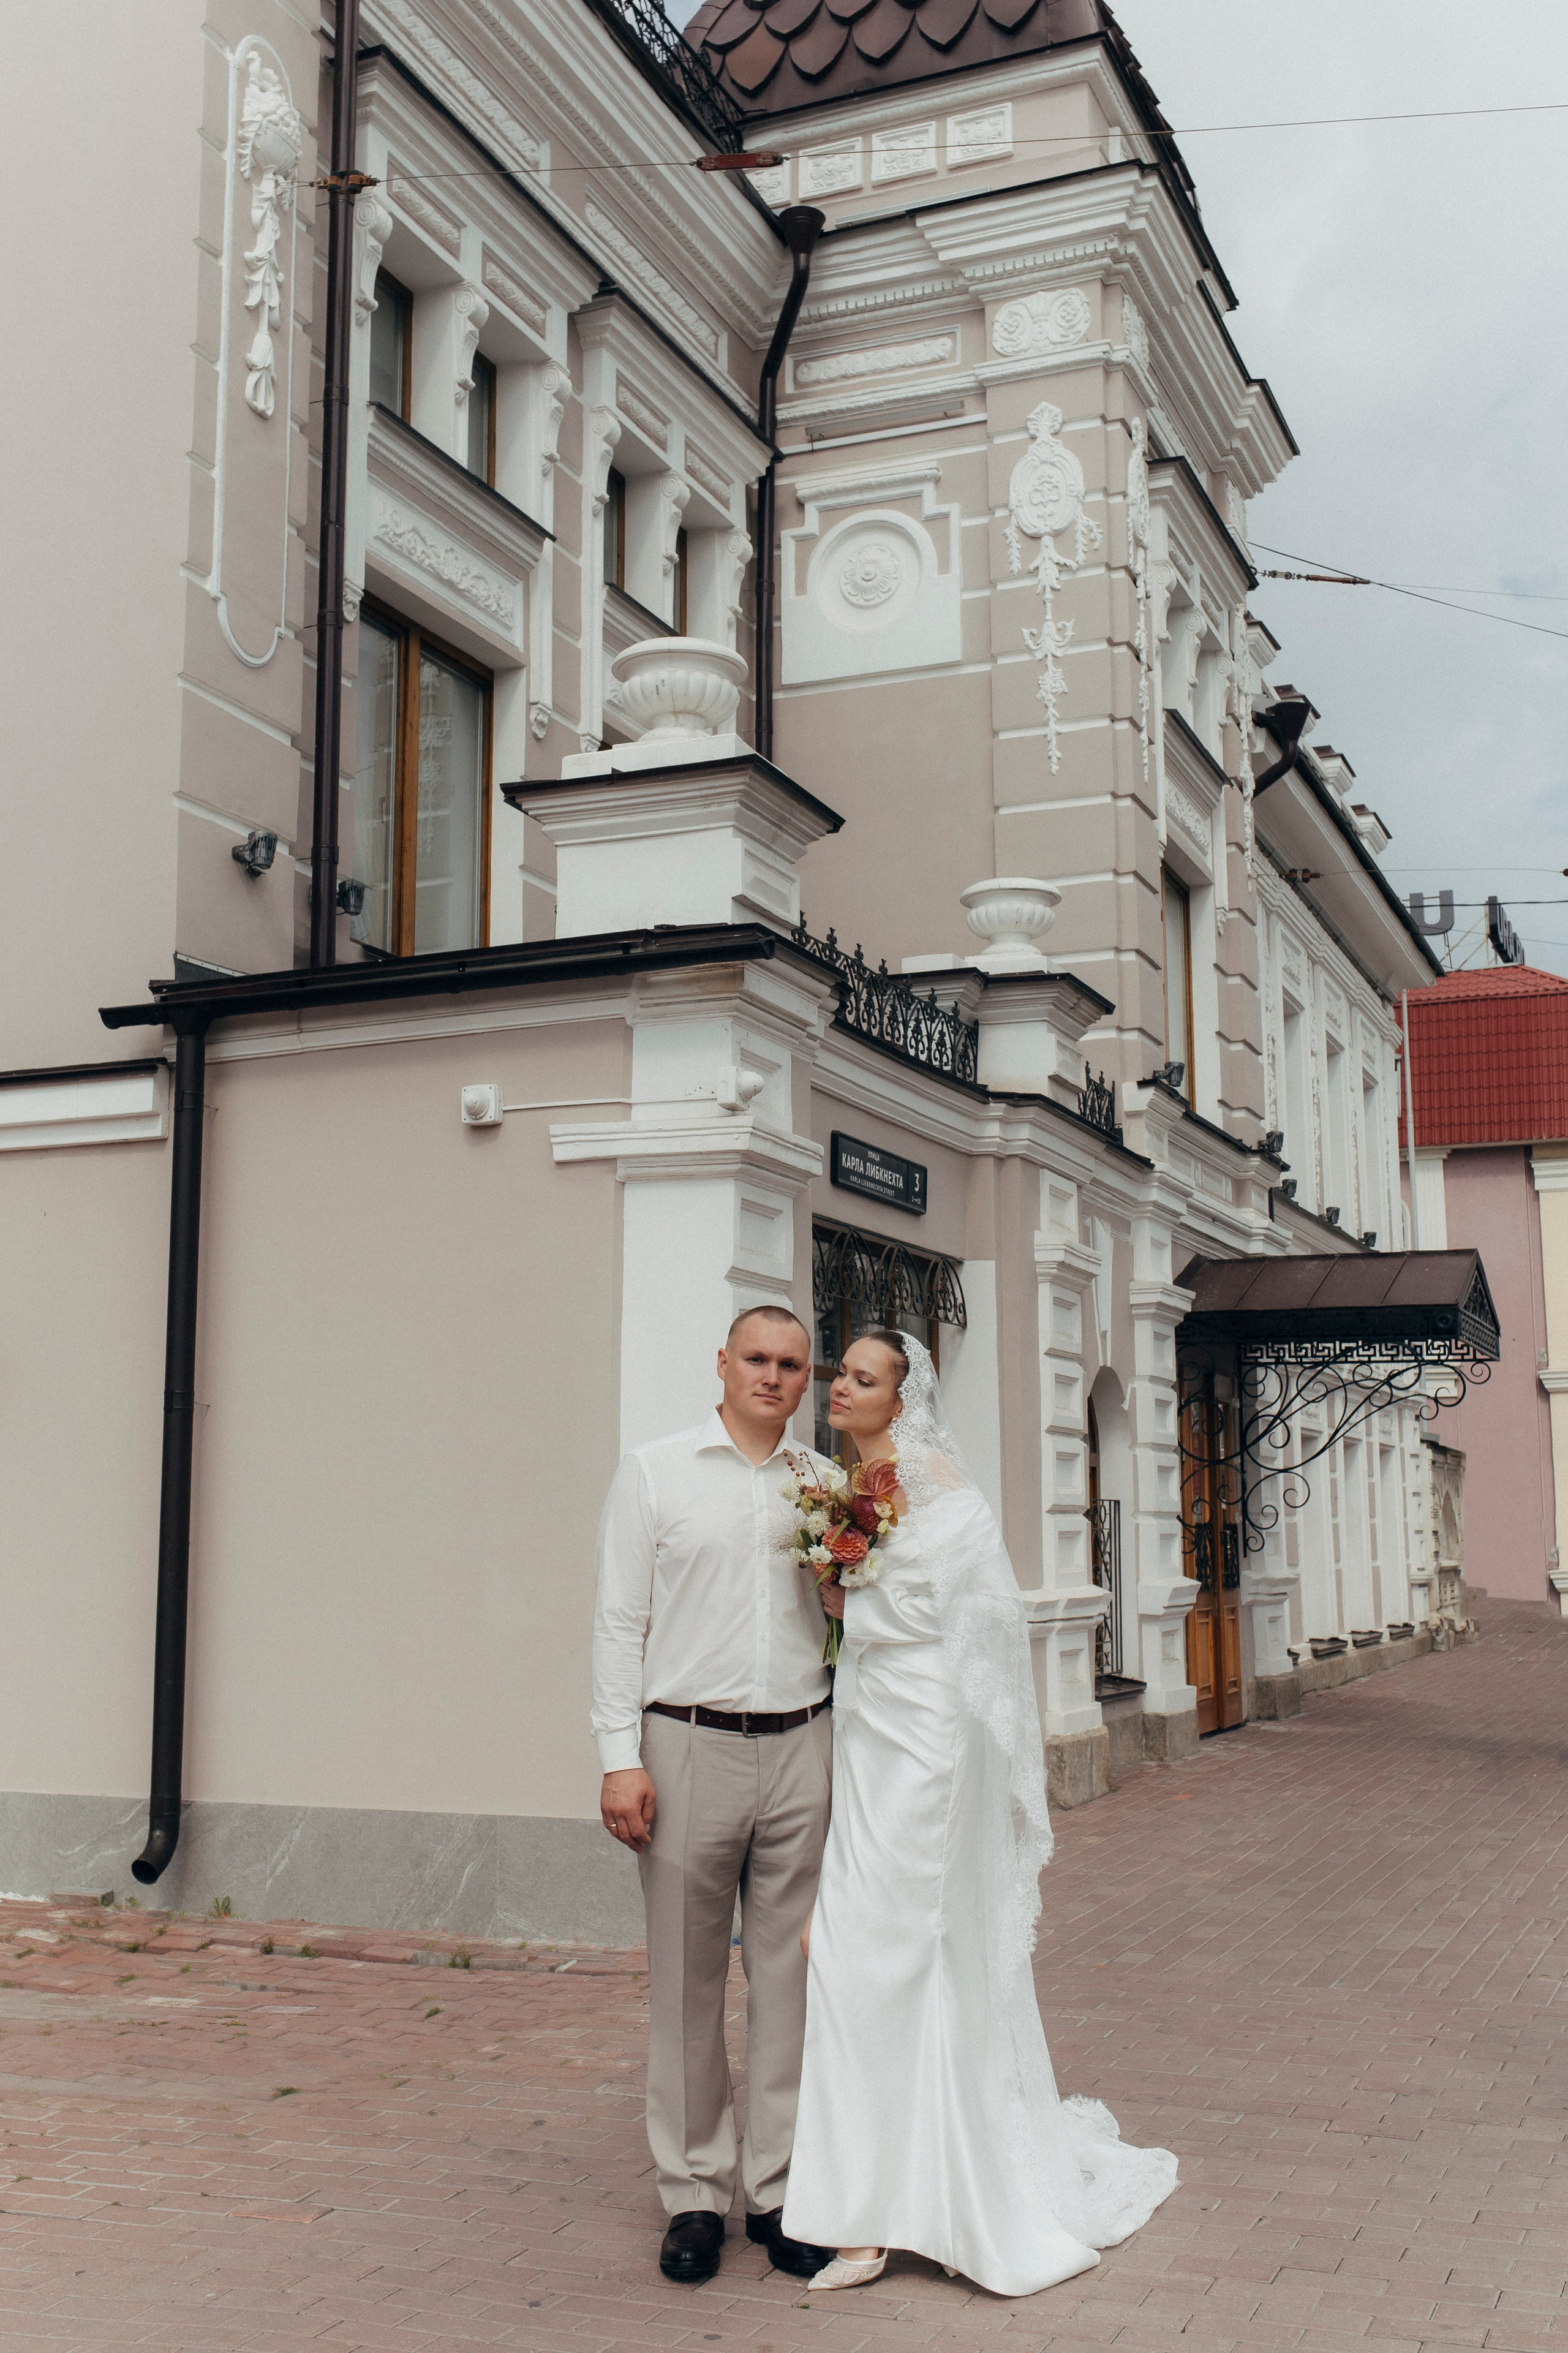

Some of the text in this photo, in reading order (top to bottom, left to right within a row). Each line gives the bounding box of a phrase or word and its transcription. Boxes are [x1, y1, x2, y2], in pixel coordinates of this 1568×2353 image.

[867, 1150, 880, 1161] УЛИЦА
[842, 1152, 903, 1189] КАРЛА ЛИБКНЕХТА
[850, 1175, 895, 1196] KARLA LIEBKNECHTA STREET
[914, 1173, 919, 1192] 3
